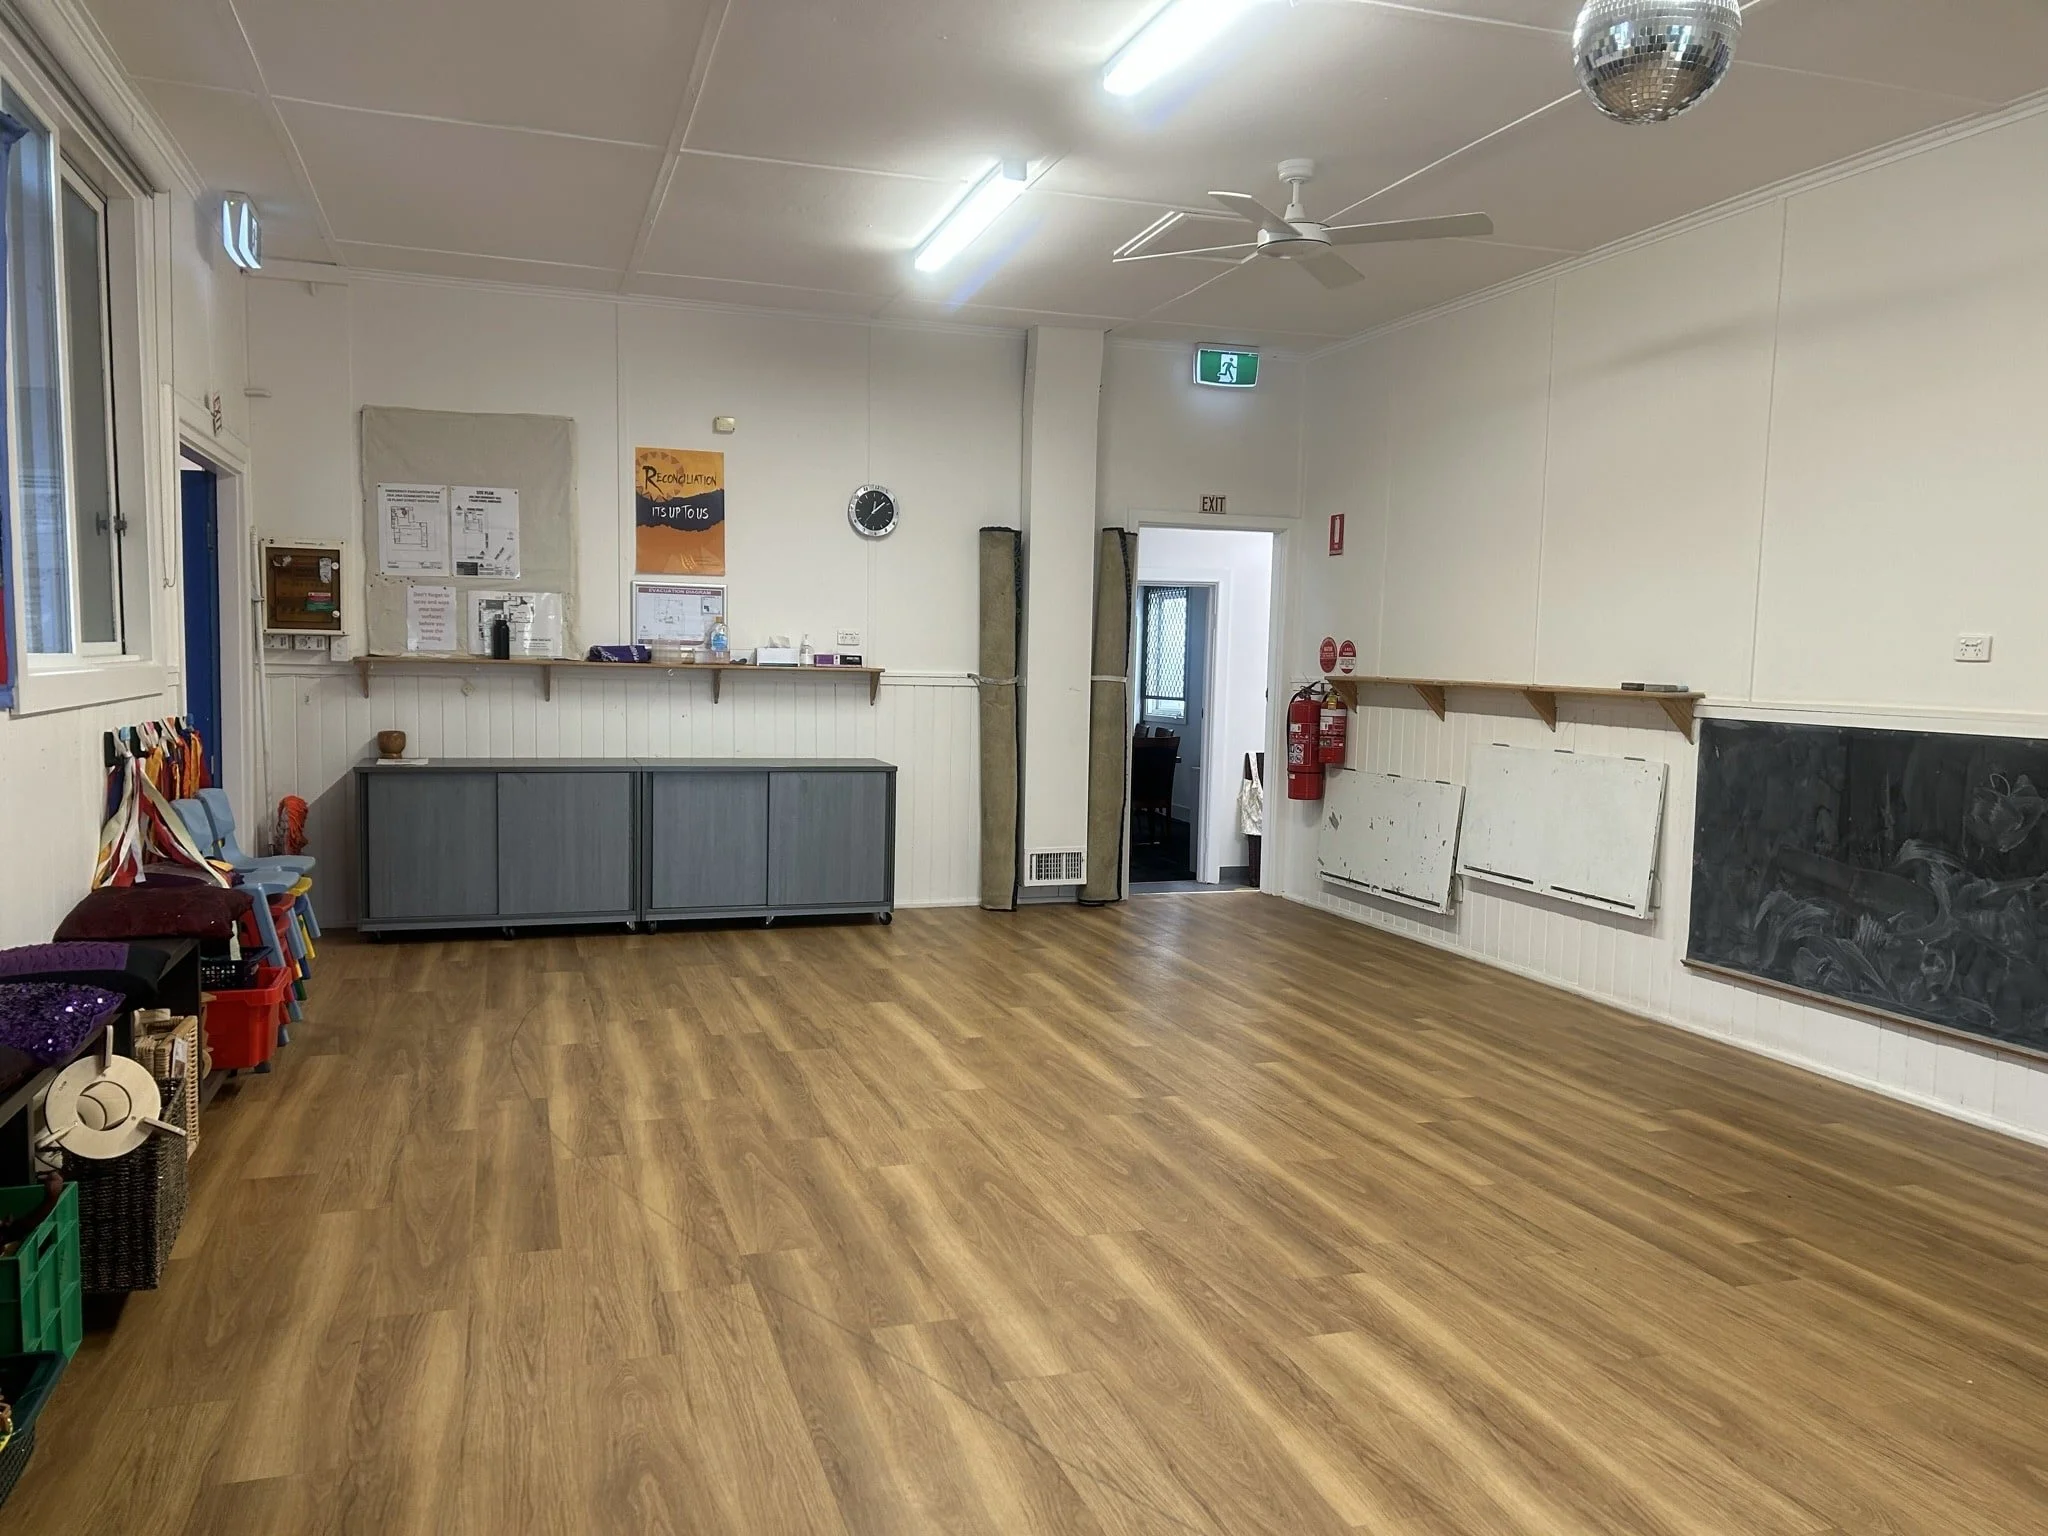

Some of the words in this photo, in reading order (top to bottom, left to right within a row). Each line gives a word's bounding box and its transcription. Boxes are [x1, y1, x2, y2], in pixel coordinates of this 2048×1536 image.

[642, 464, 717, 496] RECONCILIATION
[1202, 496, 1226, 512] EXIT
[668, 506, 681, 518] UP
[696, 507, 709, 520] US
